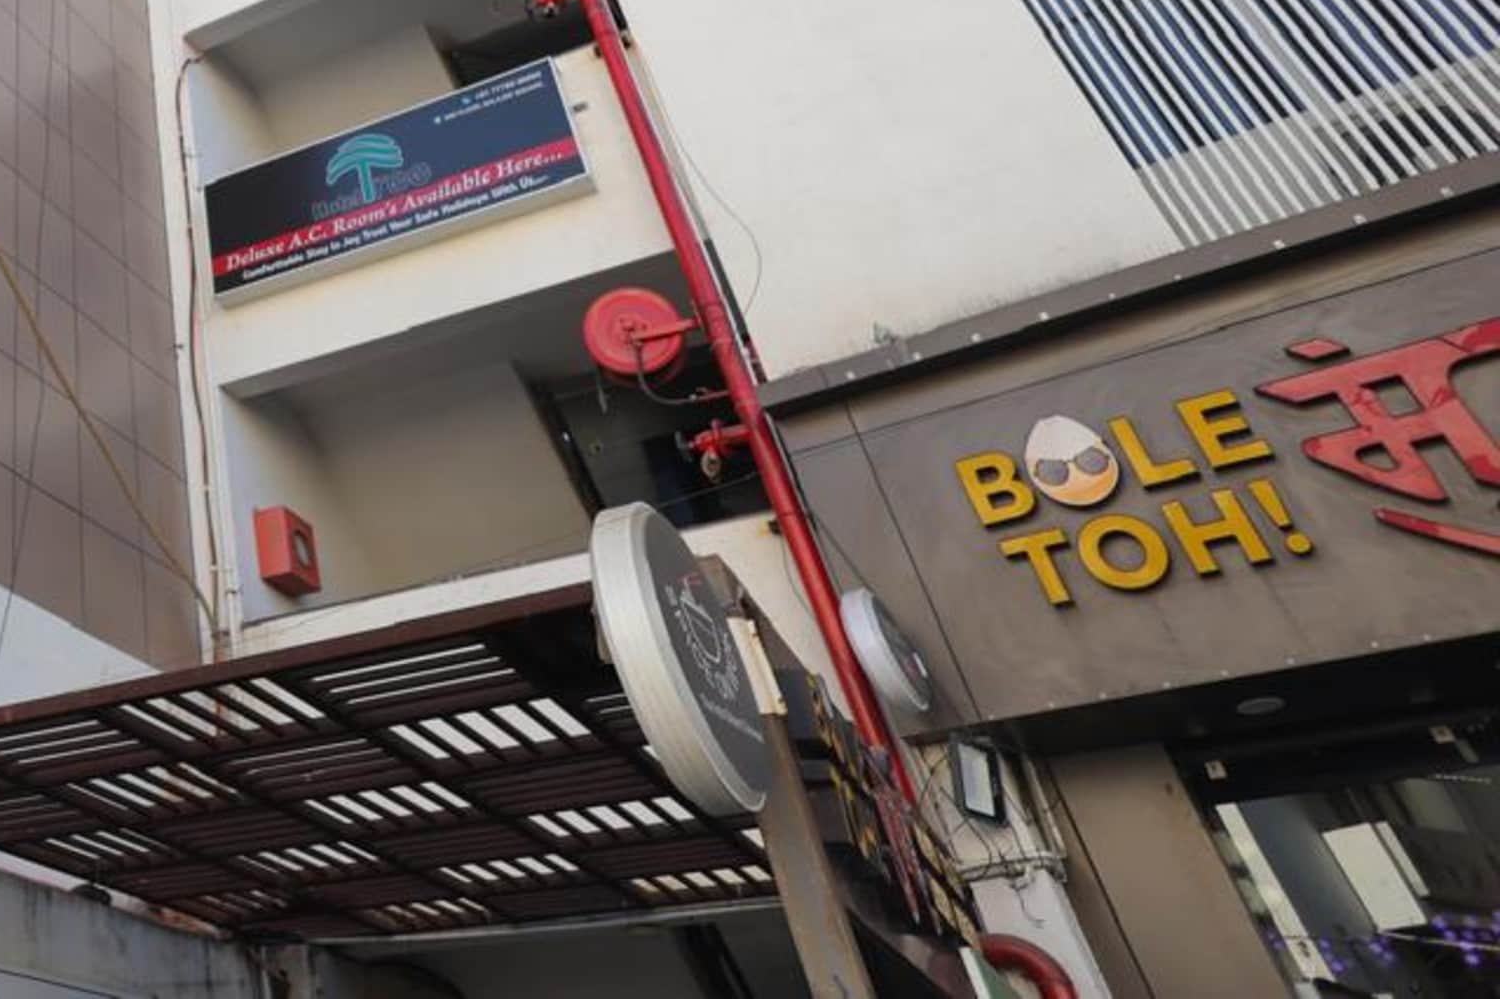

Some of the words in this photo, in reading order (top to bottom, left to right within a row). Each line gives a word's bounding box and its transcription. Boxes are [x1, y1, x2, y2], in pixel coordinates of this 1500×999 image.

[226, 240, 285, 271] Deluxe
[285, 224, 328, 250] A.C.
[329, 201, 398, 235] Room's
[400, 168, 491, 214] Available
[999, 478, 1315, 607] TOH!
